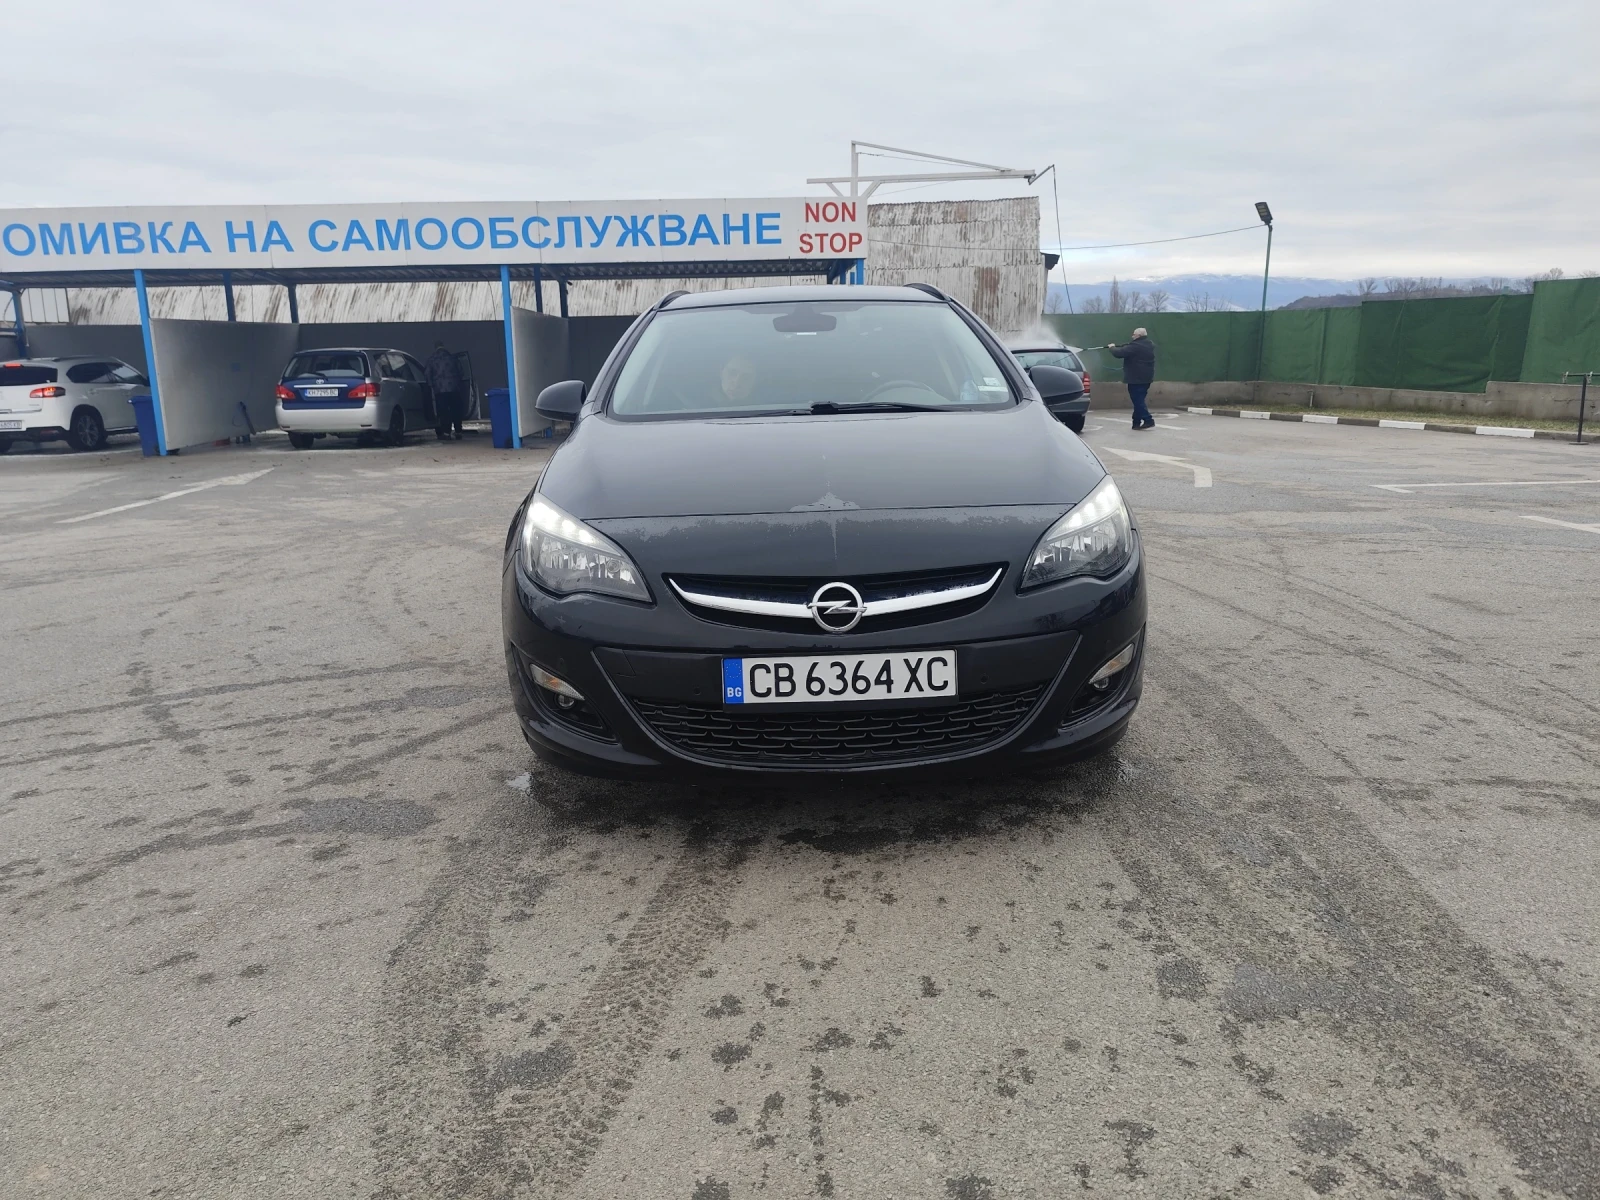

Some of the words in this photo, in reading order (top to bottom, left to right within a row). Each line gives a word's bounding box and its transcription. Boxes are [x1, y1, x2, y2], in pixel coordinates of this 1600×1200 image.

[805, 202, 856, 223] NON
[2, 222, 211, 256] ОМИВКА
[225, 220, 294, 252] НА
[308, 212, 782, 252] САМООБСЛУЖВАНЕ
[800, 232, 863, 253] STOP
[749, 662, 797, 698] CB
[805, 659, 894, 696] 6364
[903, 656, 949, 693] XC
[727, 686, 742, 698] BG
